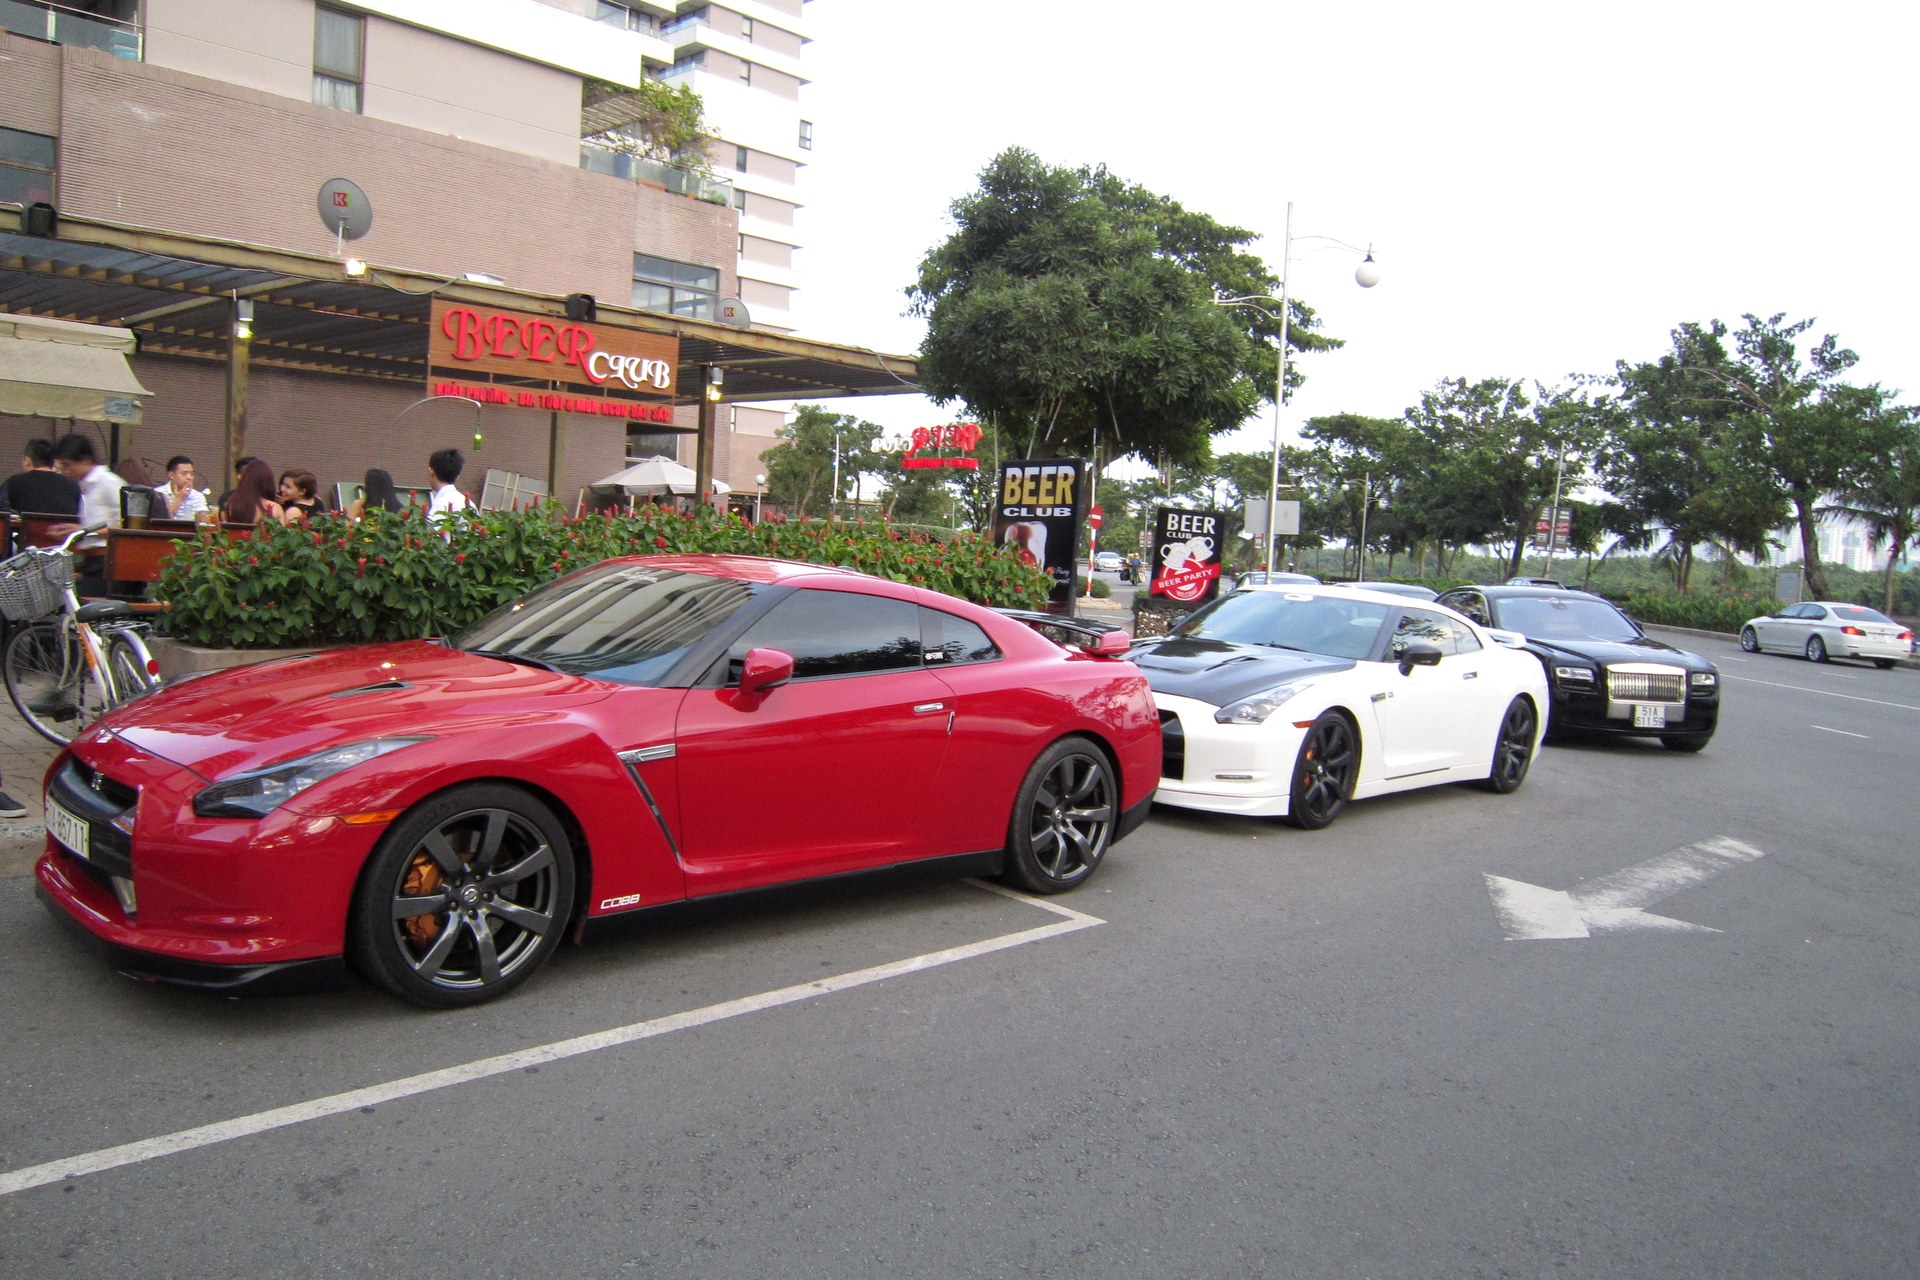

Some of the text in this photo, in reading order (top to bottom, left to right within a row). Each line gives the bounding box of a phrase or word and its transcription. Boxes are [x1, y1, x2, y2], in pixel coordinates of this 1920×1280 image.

[443, 308, 670, 389] BEER CLUB
[1003, 466, 1075, 504] BEER
[1003, 507, 1072, 517] CLUB
[1167, 513, 1215, 535] BEER
[1166, 531, 1192, 539] CLUB
[1158, 569, 1213, 588] BEER PARTY
[600, 894, 640, 909] COBB
